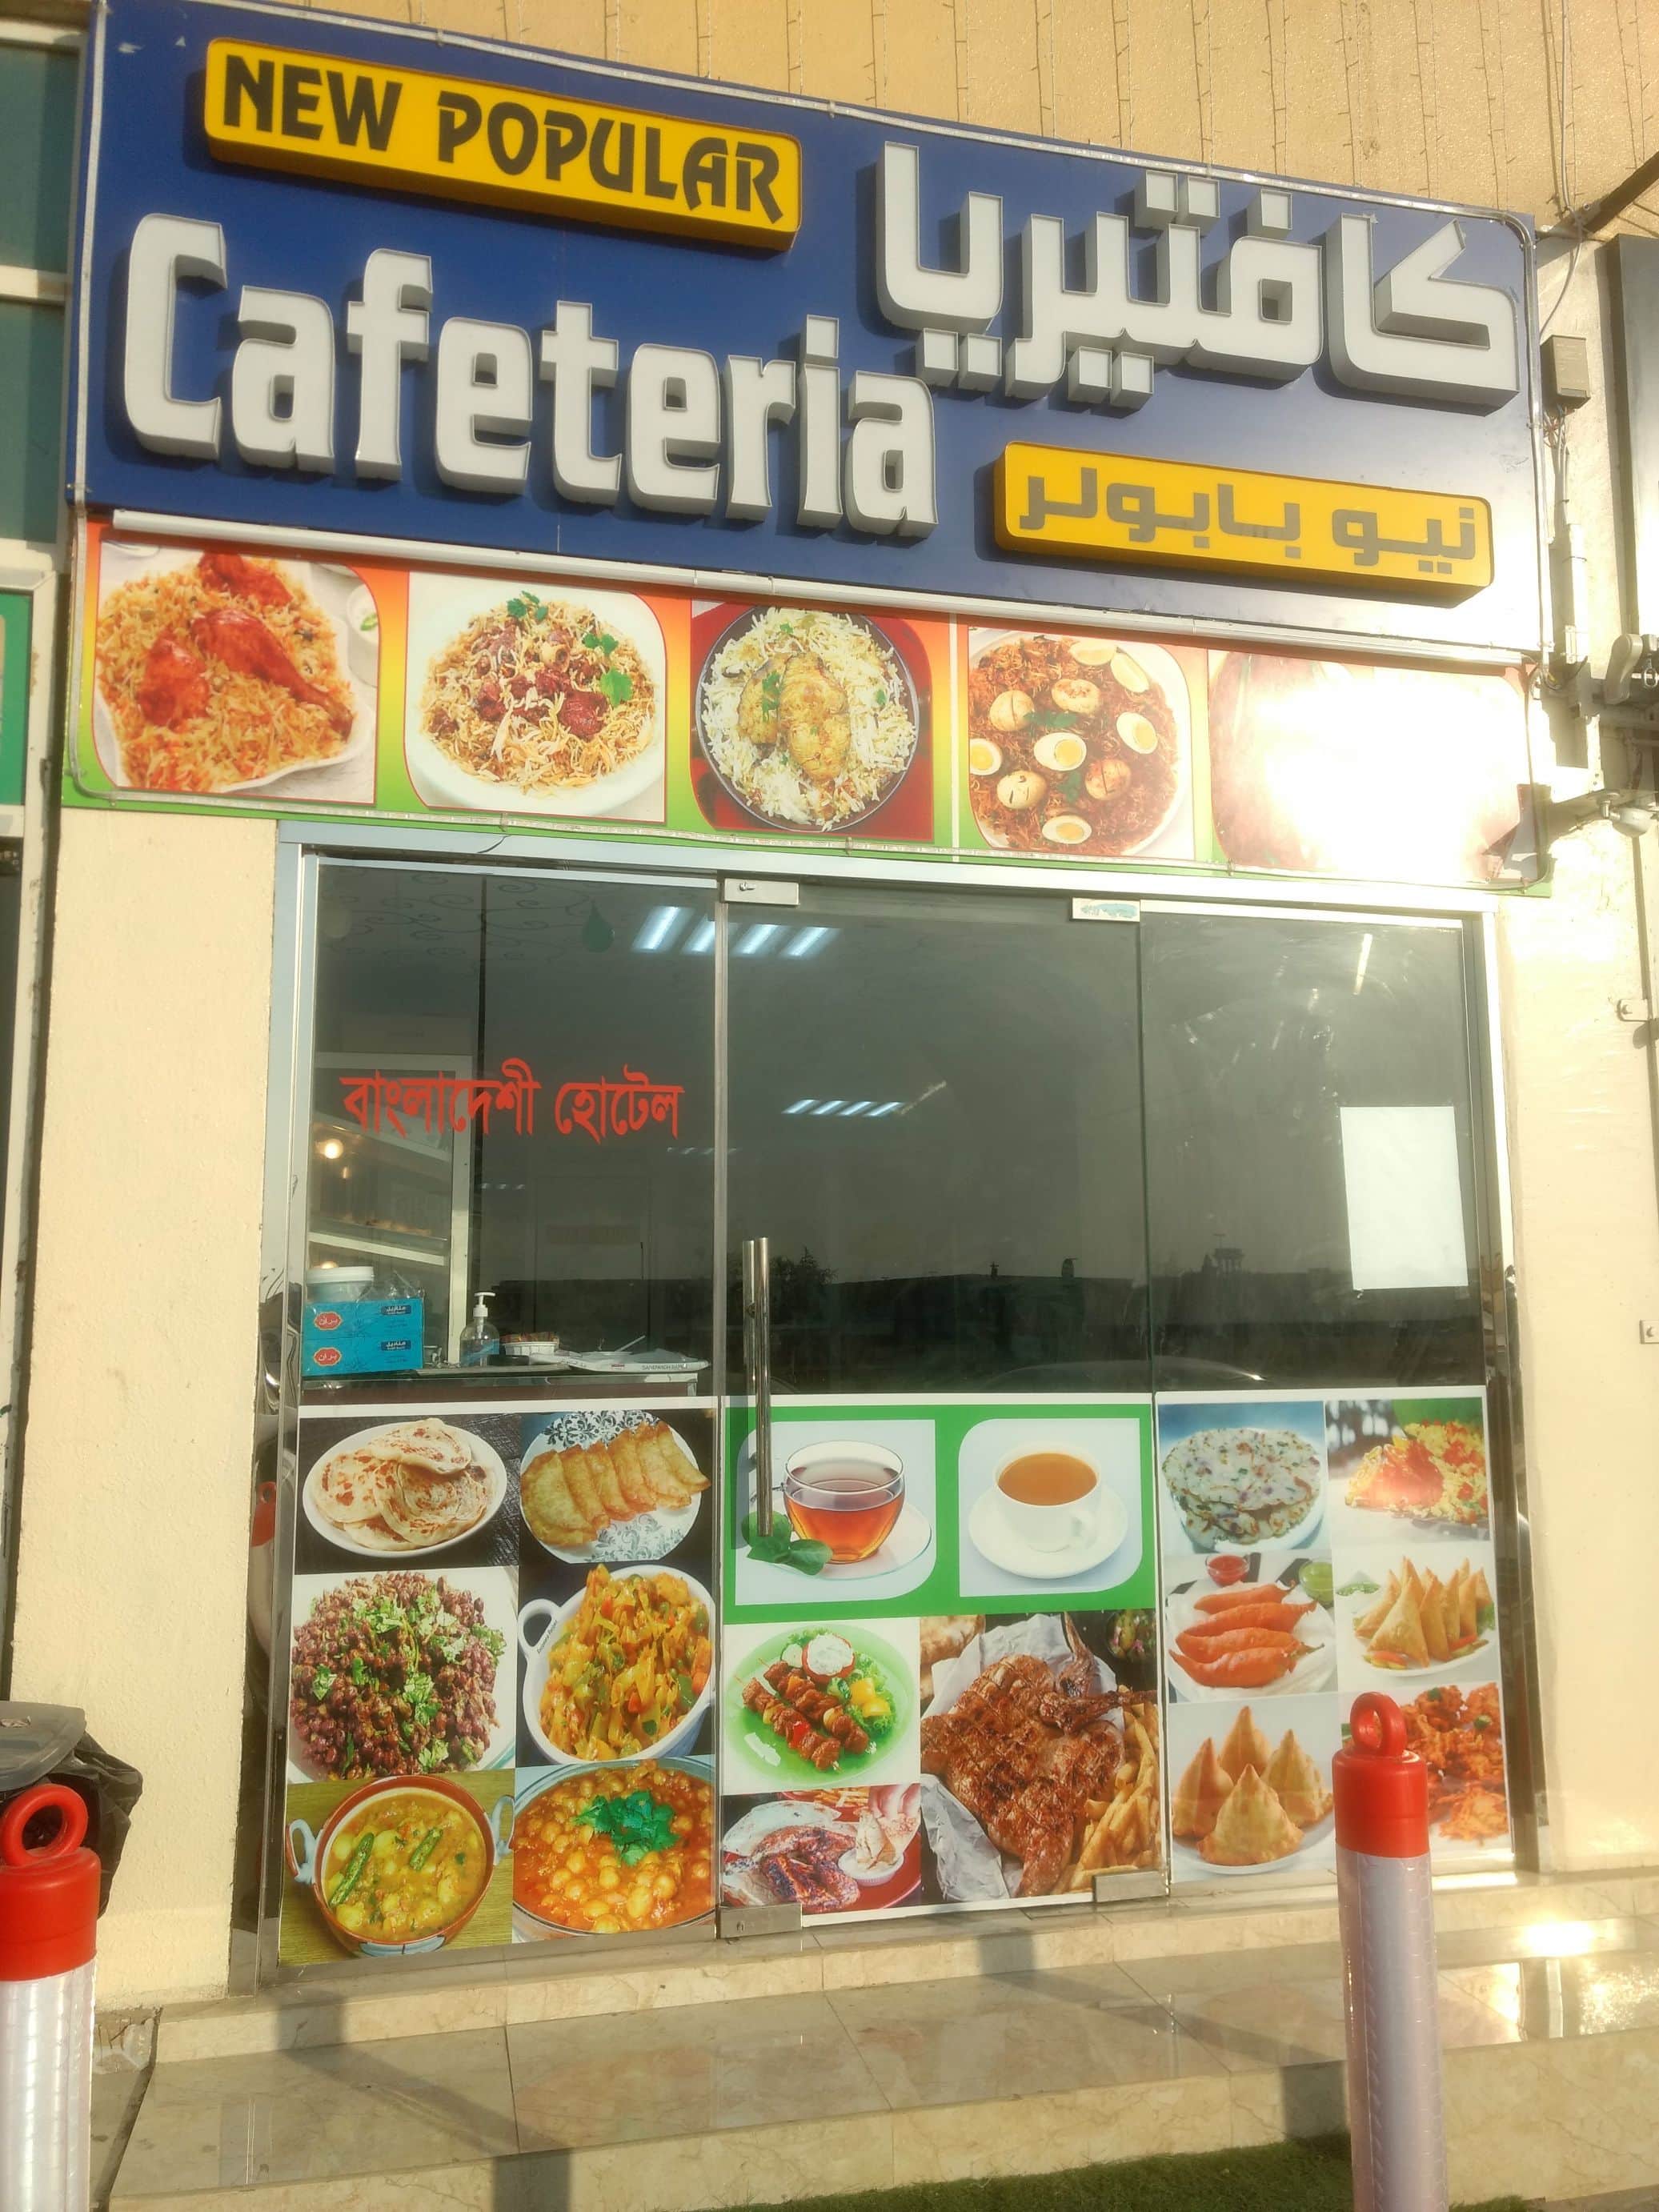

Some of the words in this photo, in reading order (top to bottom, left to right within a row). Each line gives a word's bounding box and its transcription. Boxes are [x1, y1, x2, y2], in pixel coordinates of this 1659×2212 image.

[222, 55, 402, 151] NEW
[436, 90, 783, 224] POPULAR
[877, 141, 1521, 415] كافتيريا
[123, 213, 939, 536] Cafeteria
[1020, 467, 1301, 560] بابولر
[1331, 505, 1477, 575] نيو
[339, 1057, 542, 1137] বাংলাদেশী
[555, 1064, 686, 1144] হোটেল
